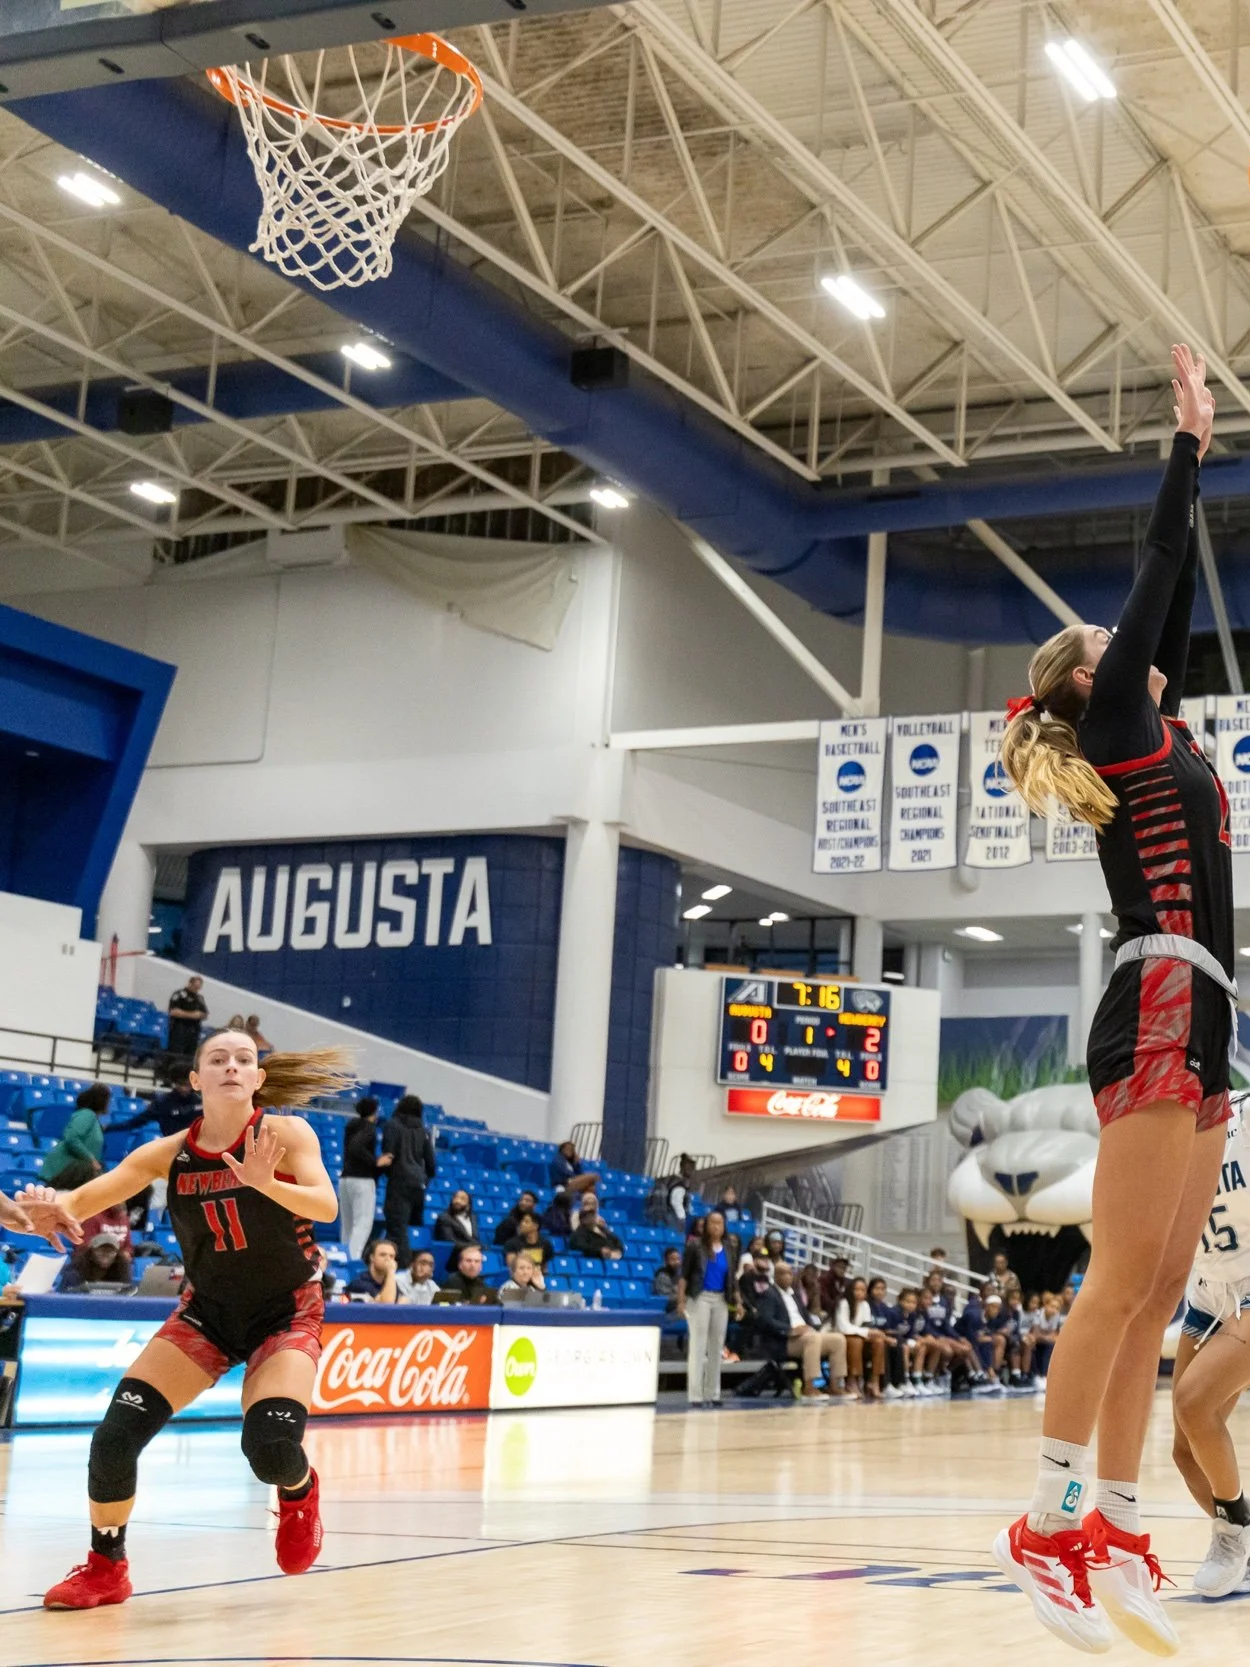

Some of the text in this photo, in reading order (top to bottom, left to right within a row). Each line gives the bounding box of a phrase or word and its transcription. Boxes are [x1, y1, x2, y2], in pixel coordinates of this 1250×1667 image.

[897, 722, 954, 736] VOLLEYBALL
[825, 742, 881, 756] BASKETBALL
[896, 784, 951, 799] SOUTHEAST
[822, 799, 876, 814] SOUTHEAST
[900, 806, 943, 820] REGIONAL
[826, 818, 872, 833] REGIONAL
[900, 827, 945, 842] CHAMPIONS
[986, 846, 1010, 860] 2012
[203, 856, 492, 953] AUGUSTA
[793, 982, 840, 1010] 7:16
[751, 1018, 767, 1044] 0
[805, 1026, 814, 1045] 1
[864, 1028, 880, 1052] 2
[734, 1051, 879, 1080] 0 4 4 0
[201, 1198, 248, 1252] 11
